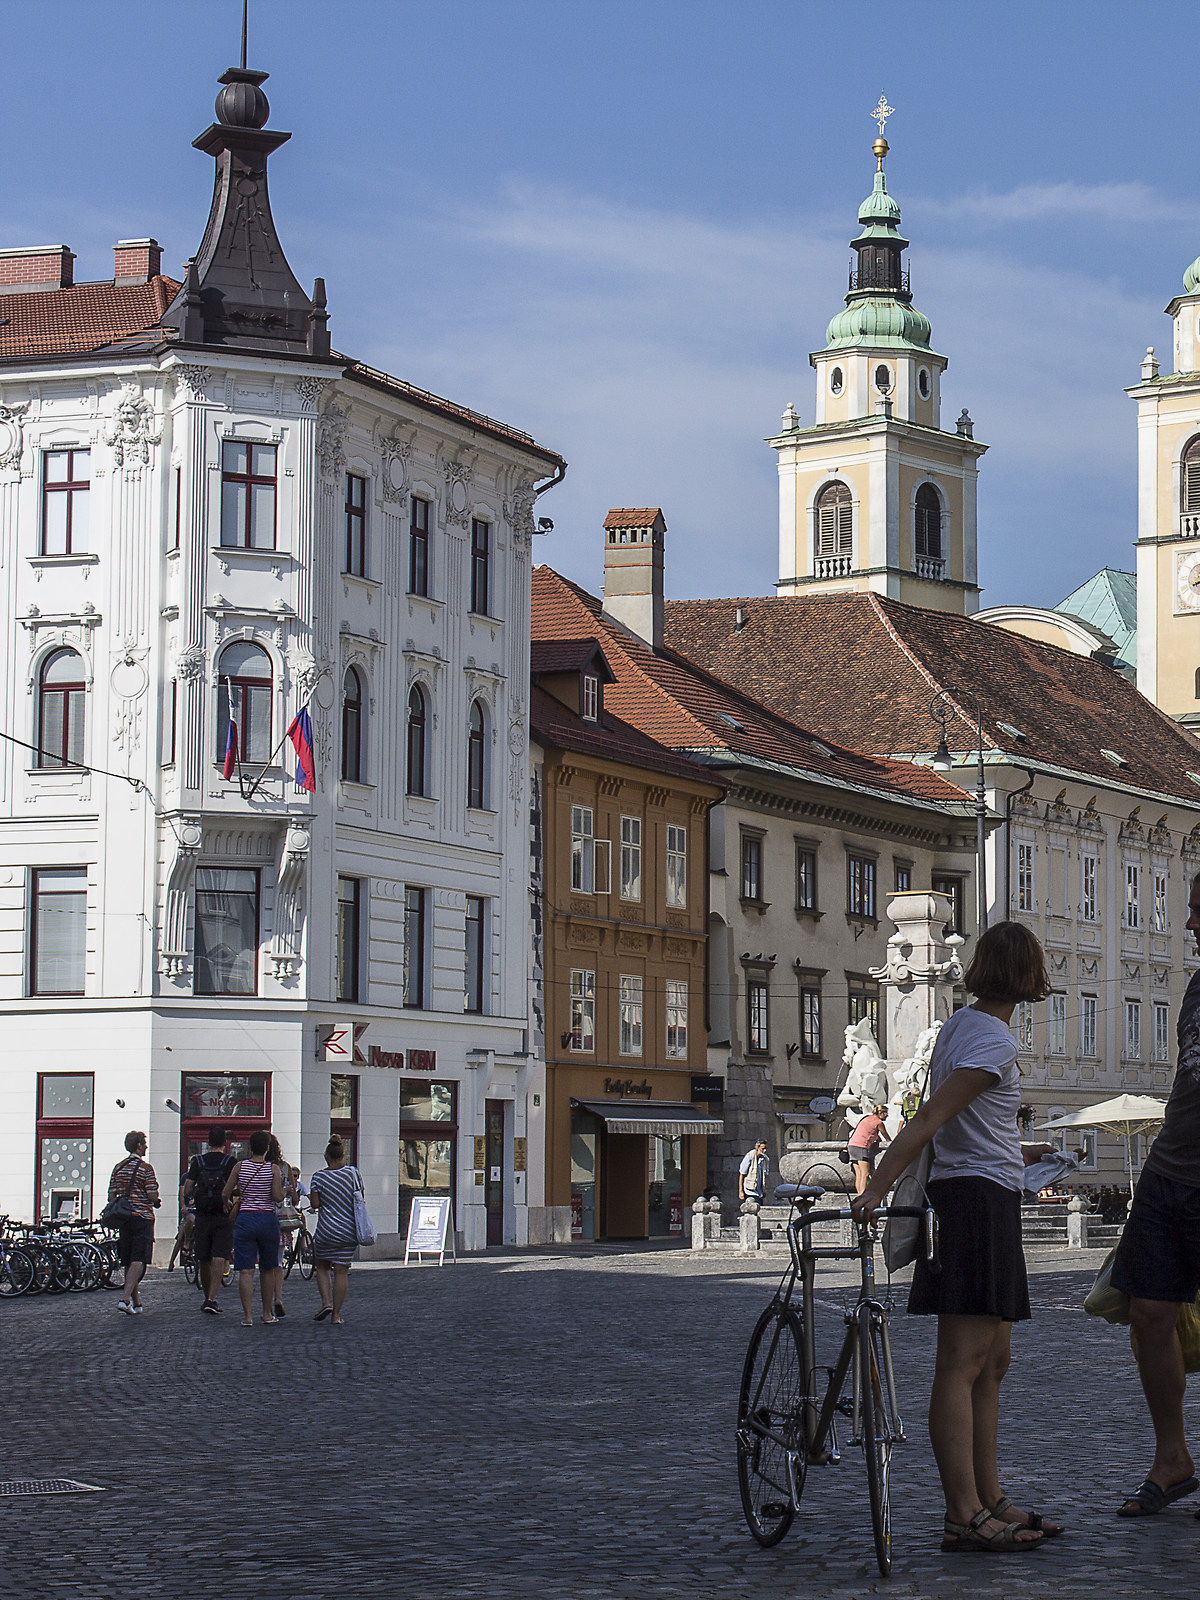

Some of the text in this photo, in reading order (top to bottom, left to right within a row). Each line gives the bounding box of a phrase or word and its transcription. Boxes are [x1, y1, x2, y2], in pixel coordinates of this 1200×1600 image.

[368, 1045, 436, 1071] Nova KBM
[209, 1098, 262, 1107] Nova KBM
